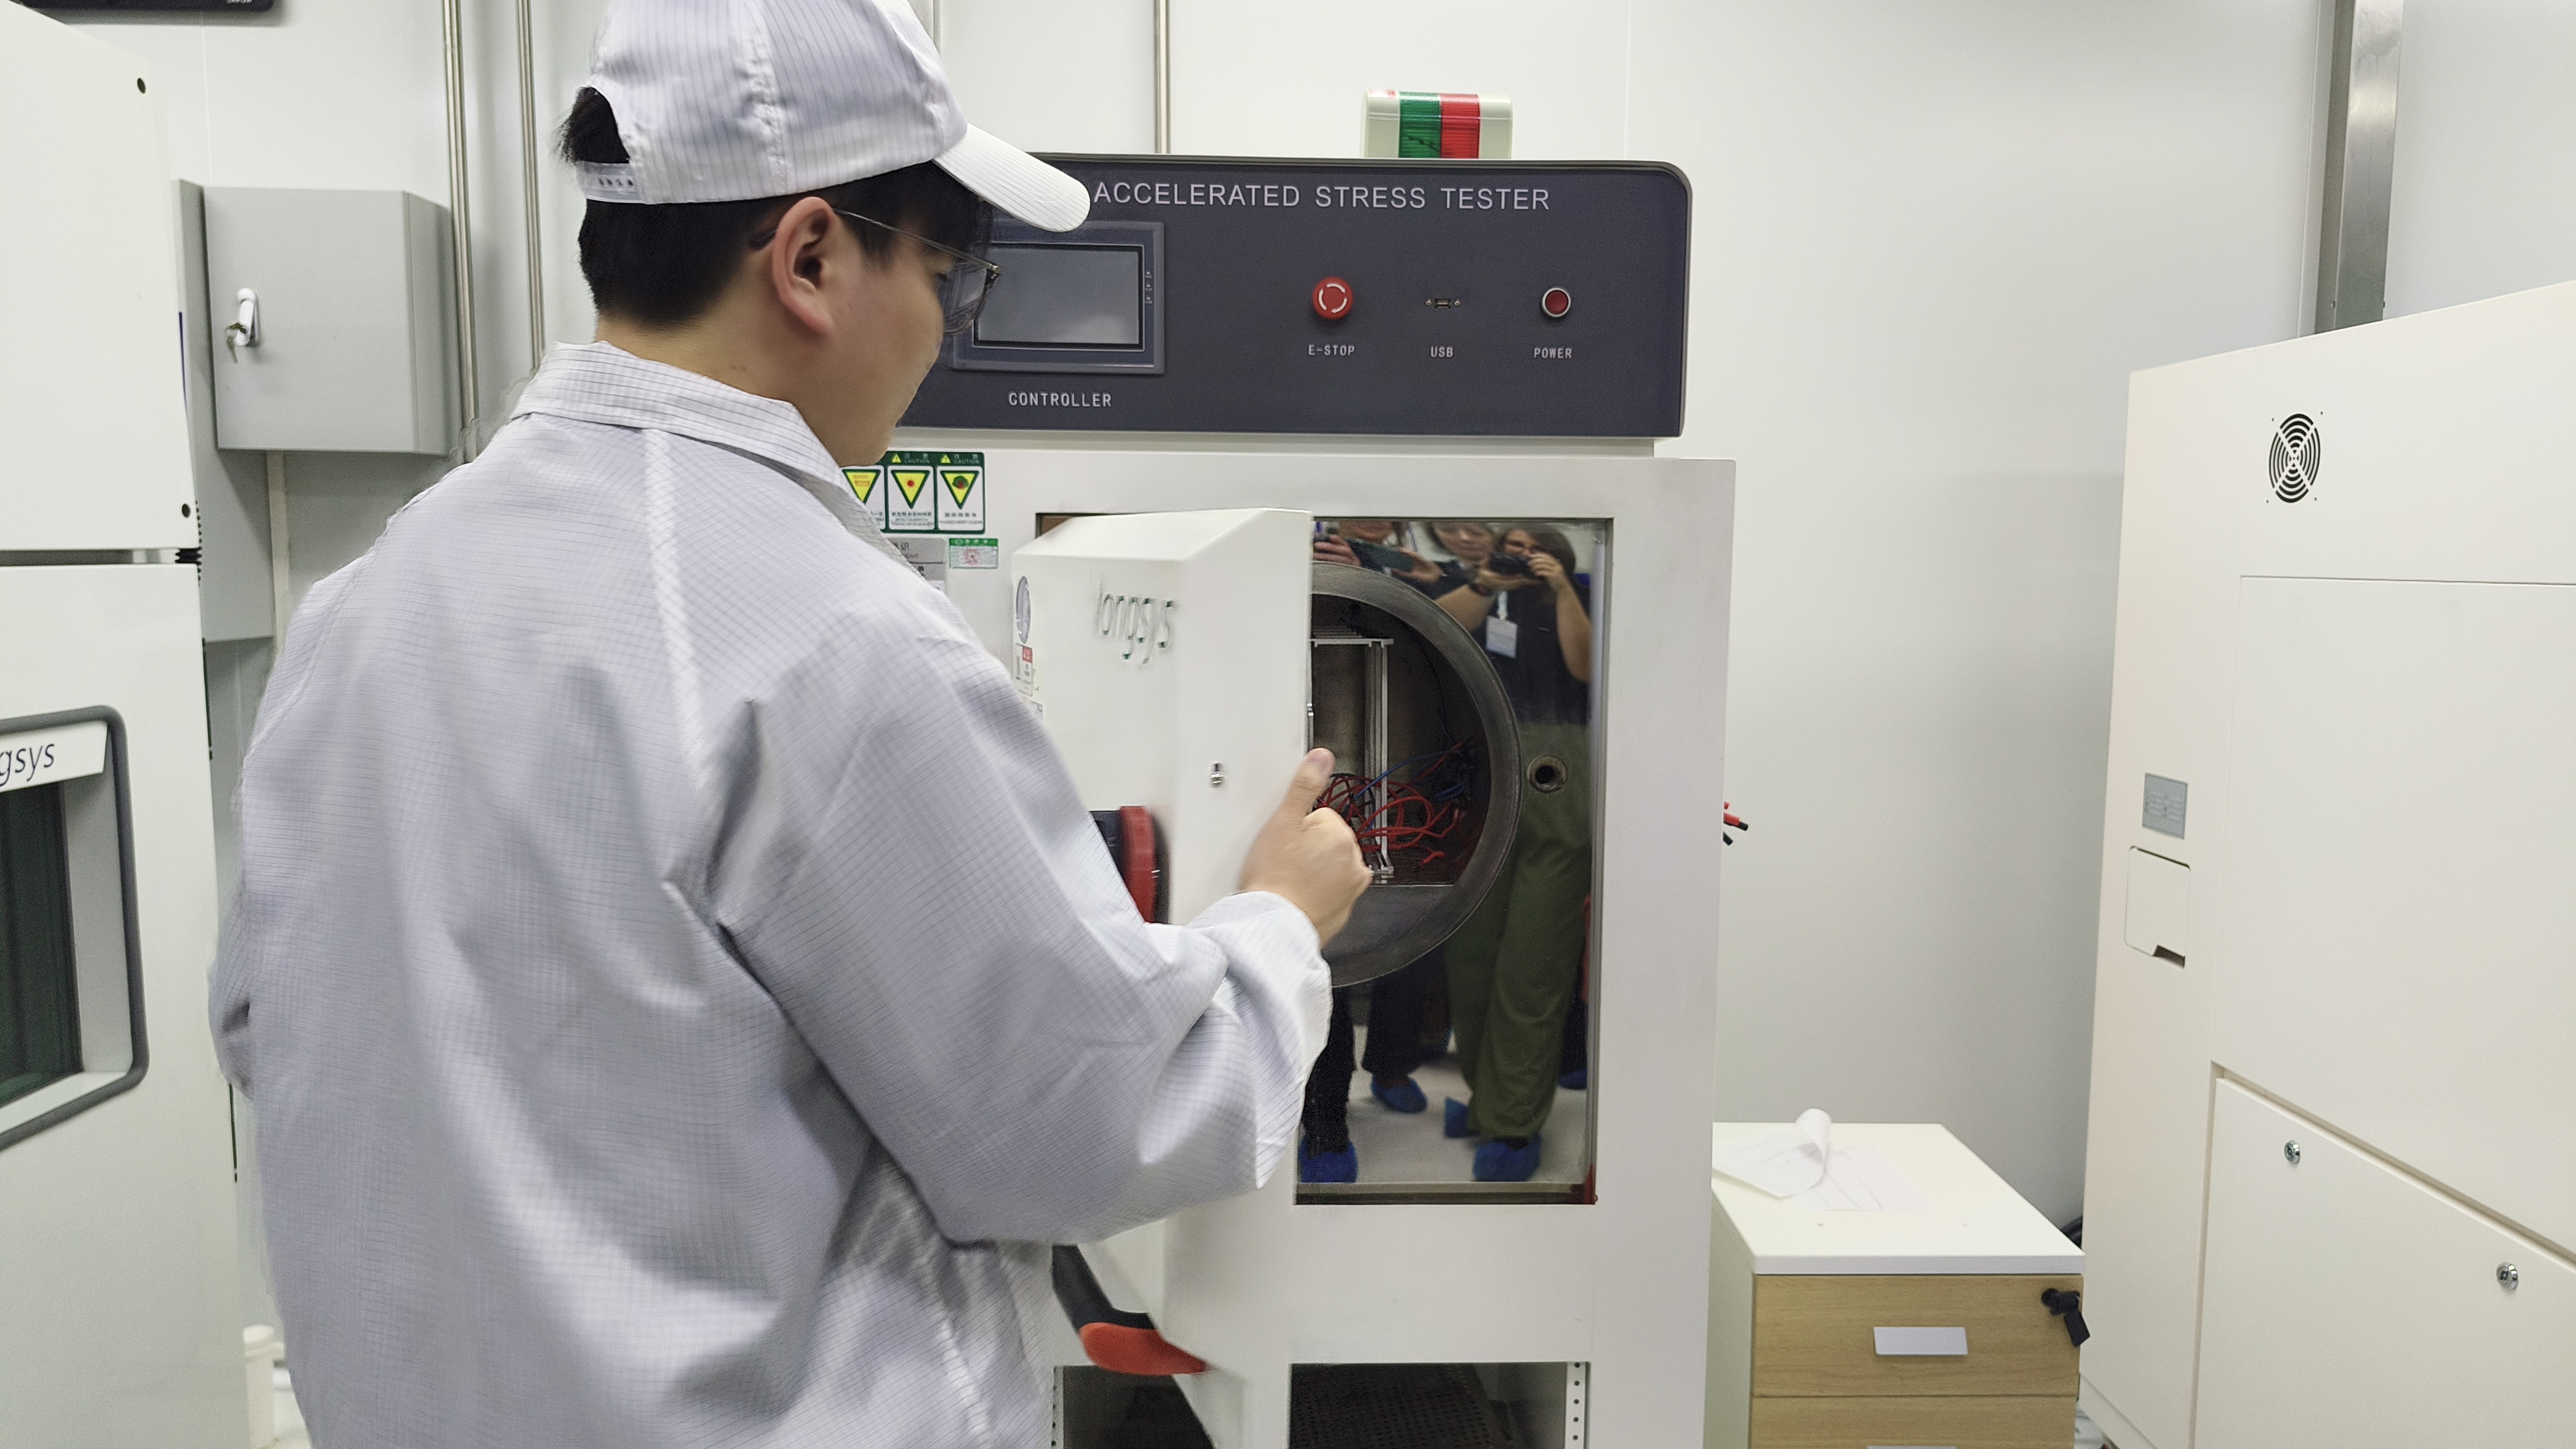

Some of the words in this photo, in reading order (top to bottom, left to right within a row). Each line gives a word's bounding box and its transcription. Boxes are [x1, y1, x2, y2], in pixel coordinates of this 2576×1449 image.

[1093, 182, 1300, 207] ACCELERATED
[1315, 186, 1426, 209] STRESS
[1440, 188, 1550, 210] TESTER
[1308, 344, 1355, 356] E-STOP
[1430, 346, 1453, 358] USB
[1533, 348, 1573, 359] POWER
[1008, 392, 1112, 408] CONTROLLER
